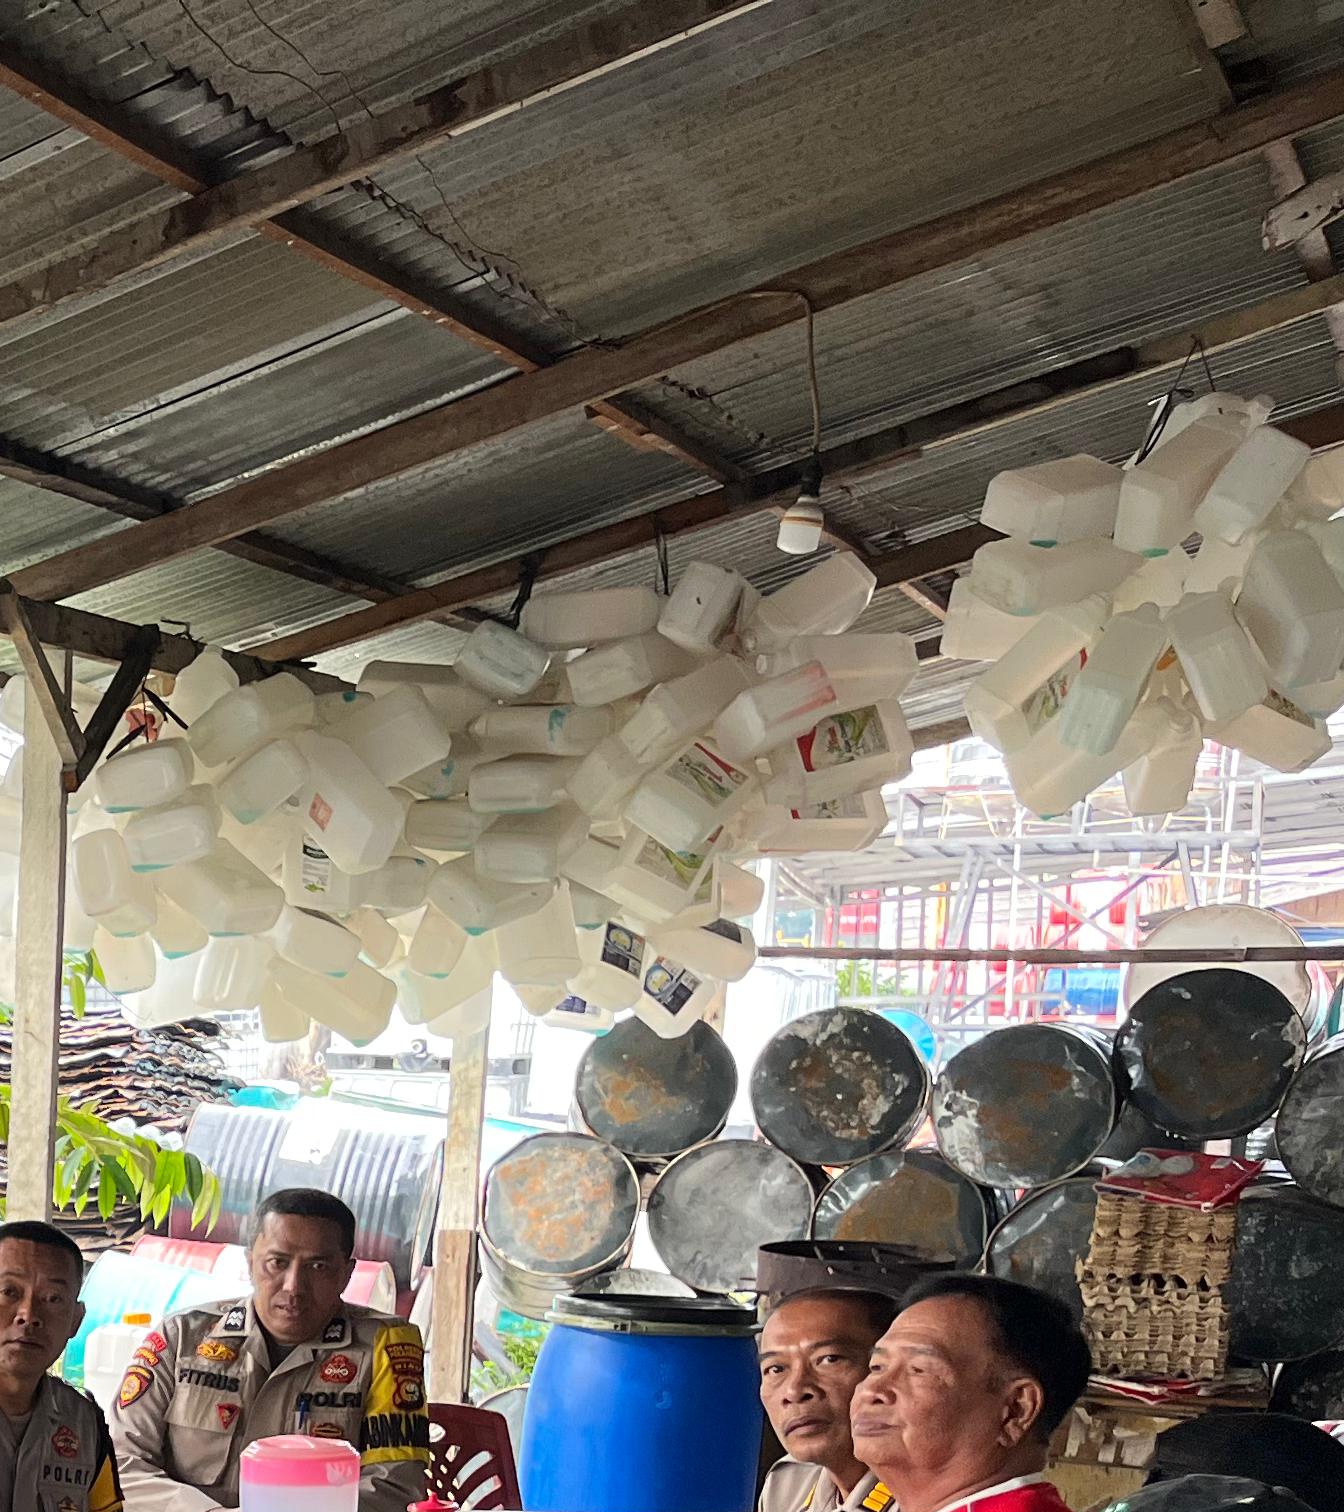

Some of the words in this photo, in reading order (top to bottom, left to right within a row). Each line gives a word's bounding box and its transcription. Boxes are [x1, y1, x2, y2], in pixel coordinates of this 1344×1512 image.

[178, 1368, 240, 1392] FITRUS
[296, 1391, 362, 1407] POLRI
[43, 1465, 91, 1486] POLRI
